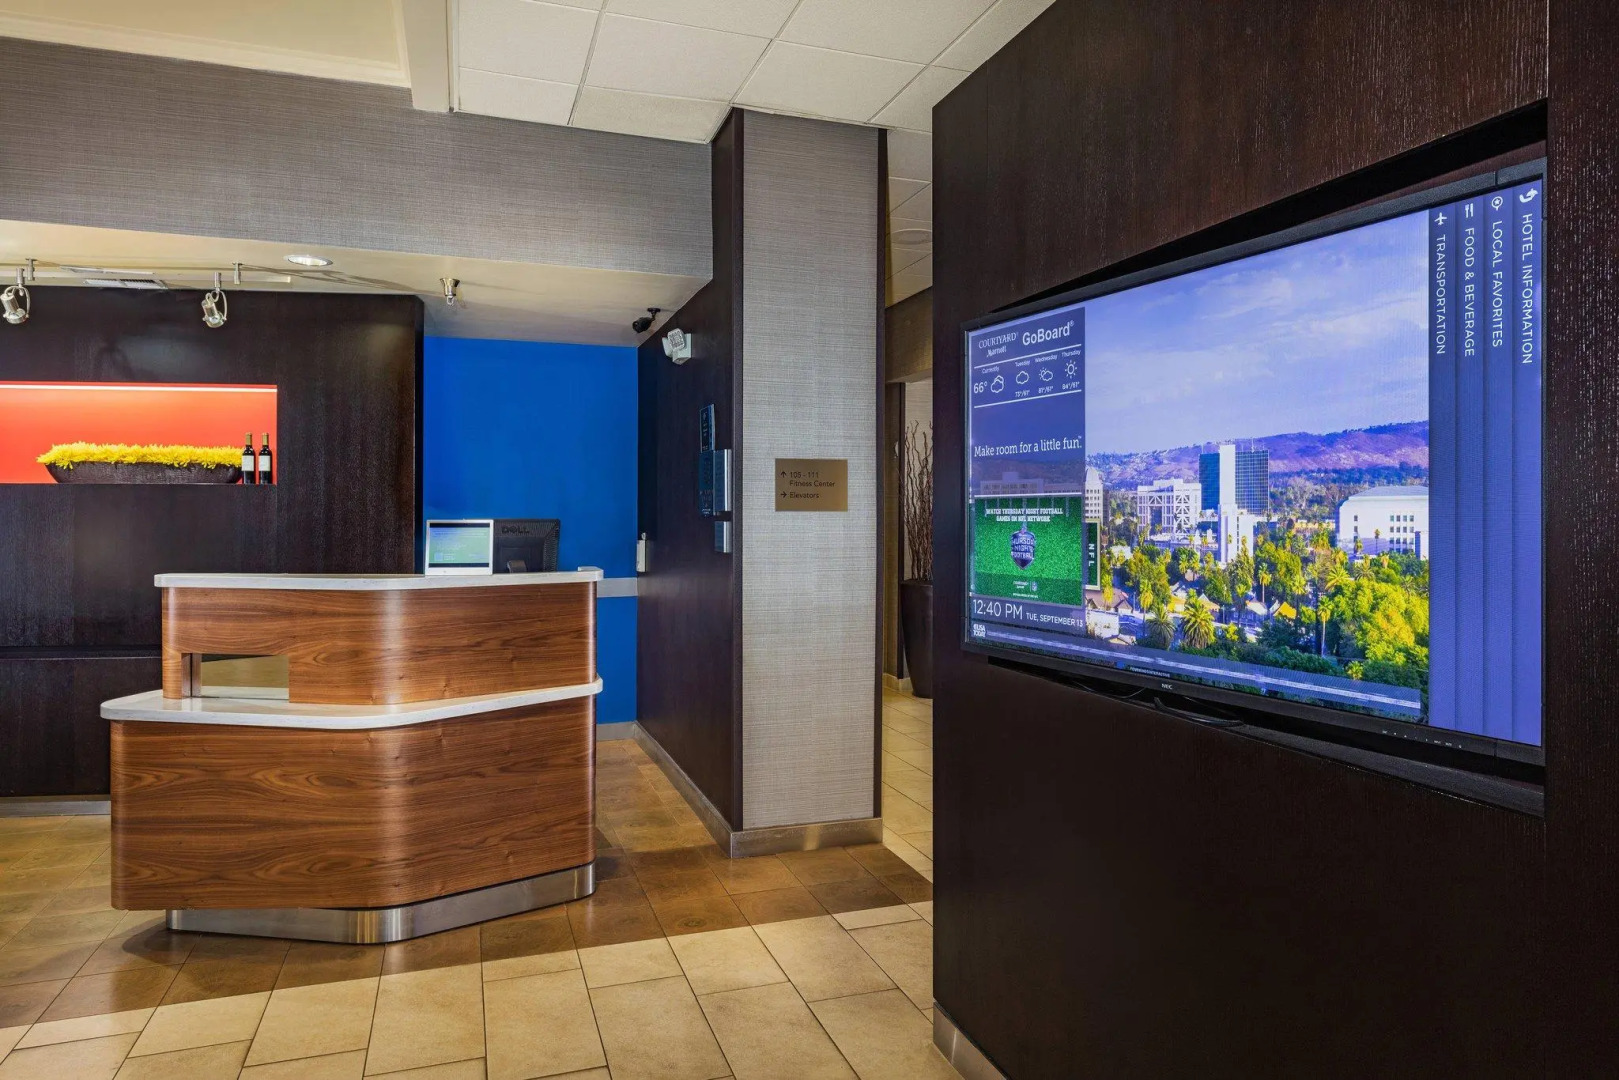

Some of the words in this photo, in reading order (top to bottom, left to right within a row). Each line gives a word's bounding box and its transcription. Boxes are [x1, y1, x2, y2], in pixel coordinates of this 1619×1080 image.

[1492, 220, 1503, 268] LOCAL
[1522, 213, 1533, 261] HOTEL
[1464, 227, 1475, 267] FOOD
[1464, 271, 1475, 280] &
[1436, 234, 1446, 355] TRANSPORTATION
[1492, 271, 1503, 348] FAVORITES
[1522, 264, 1533, 364] INFORMATION
[1464, 284, 1475, 357] BEVERAGE
[978, 332, 1017, 349] COURTYARD
[1034, 354, 1058, 363] Wednesday
[1061, 348, 1081, 358] Thursday
[1015, 359, 1030, 367] Tuesday
[974, 445, 995, 457] Make
[996, 445, 1018, 455] room
[1019, 441, 1032, 453] for
[1033, 442, 1039, 452] a
[1040, 438, 1061, 451] little
[789, 491, 820, 499] Elevators
[501, 525, 530, 534] DELL
[972, 599, 1002, 617] 12:40
[1005, 603, 1023, 620] PM
[1039, 614, 1076, 626] SEPTEMBER
[1076, 619, 1083, 627] 13
[975, 624, 986, 632] USA
